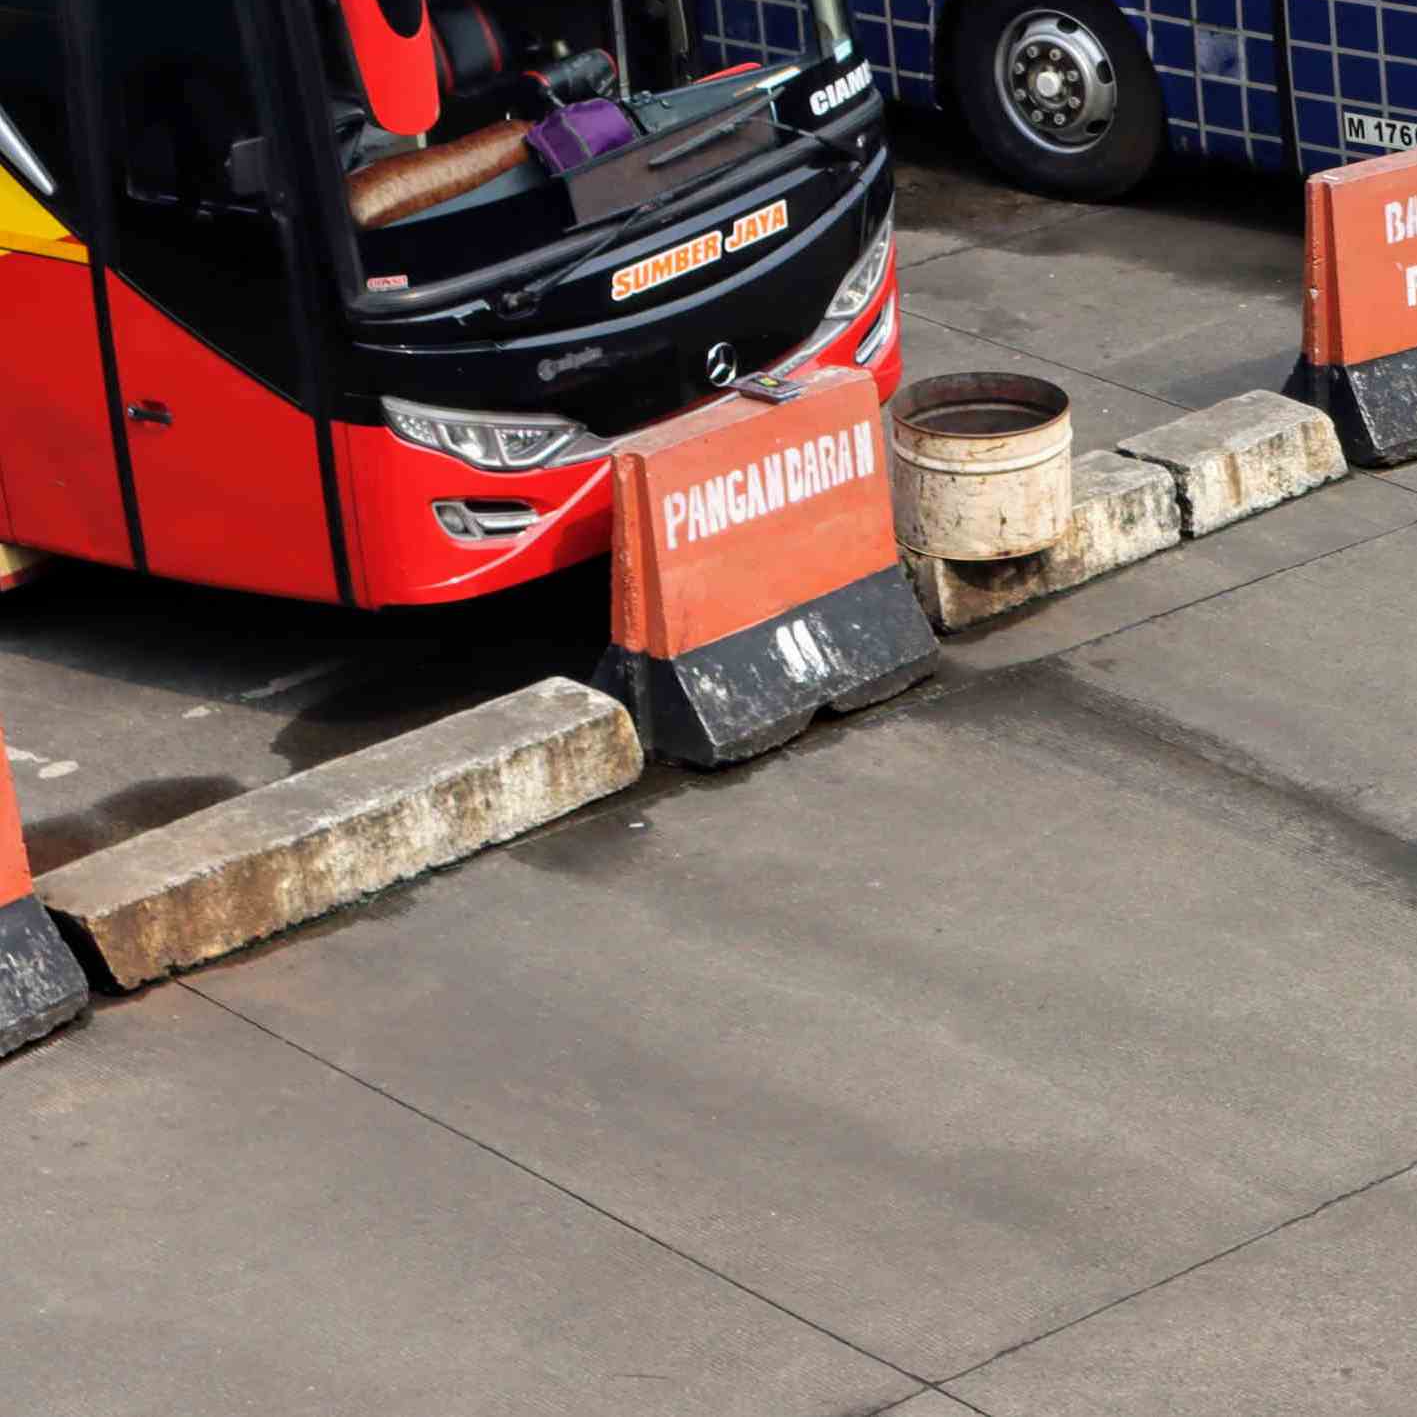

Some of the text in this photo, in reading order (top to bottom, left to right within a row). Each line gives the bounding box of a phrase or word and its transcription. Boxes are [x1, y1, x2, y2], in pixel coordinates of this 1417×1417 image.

[1349, 117, 1366, 140] M
[612, 198, 788, 301] SUMBER JAYA
[663, 420, 876, 551] PANGANDARAN
